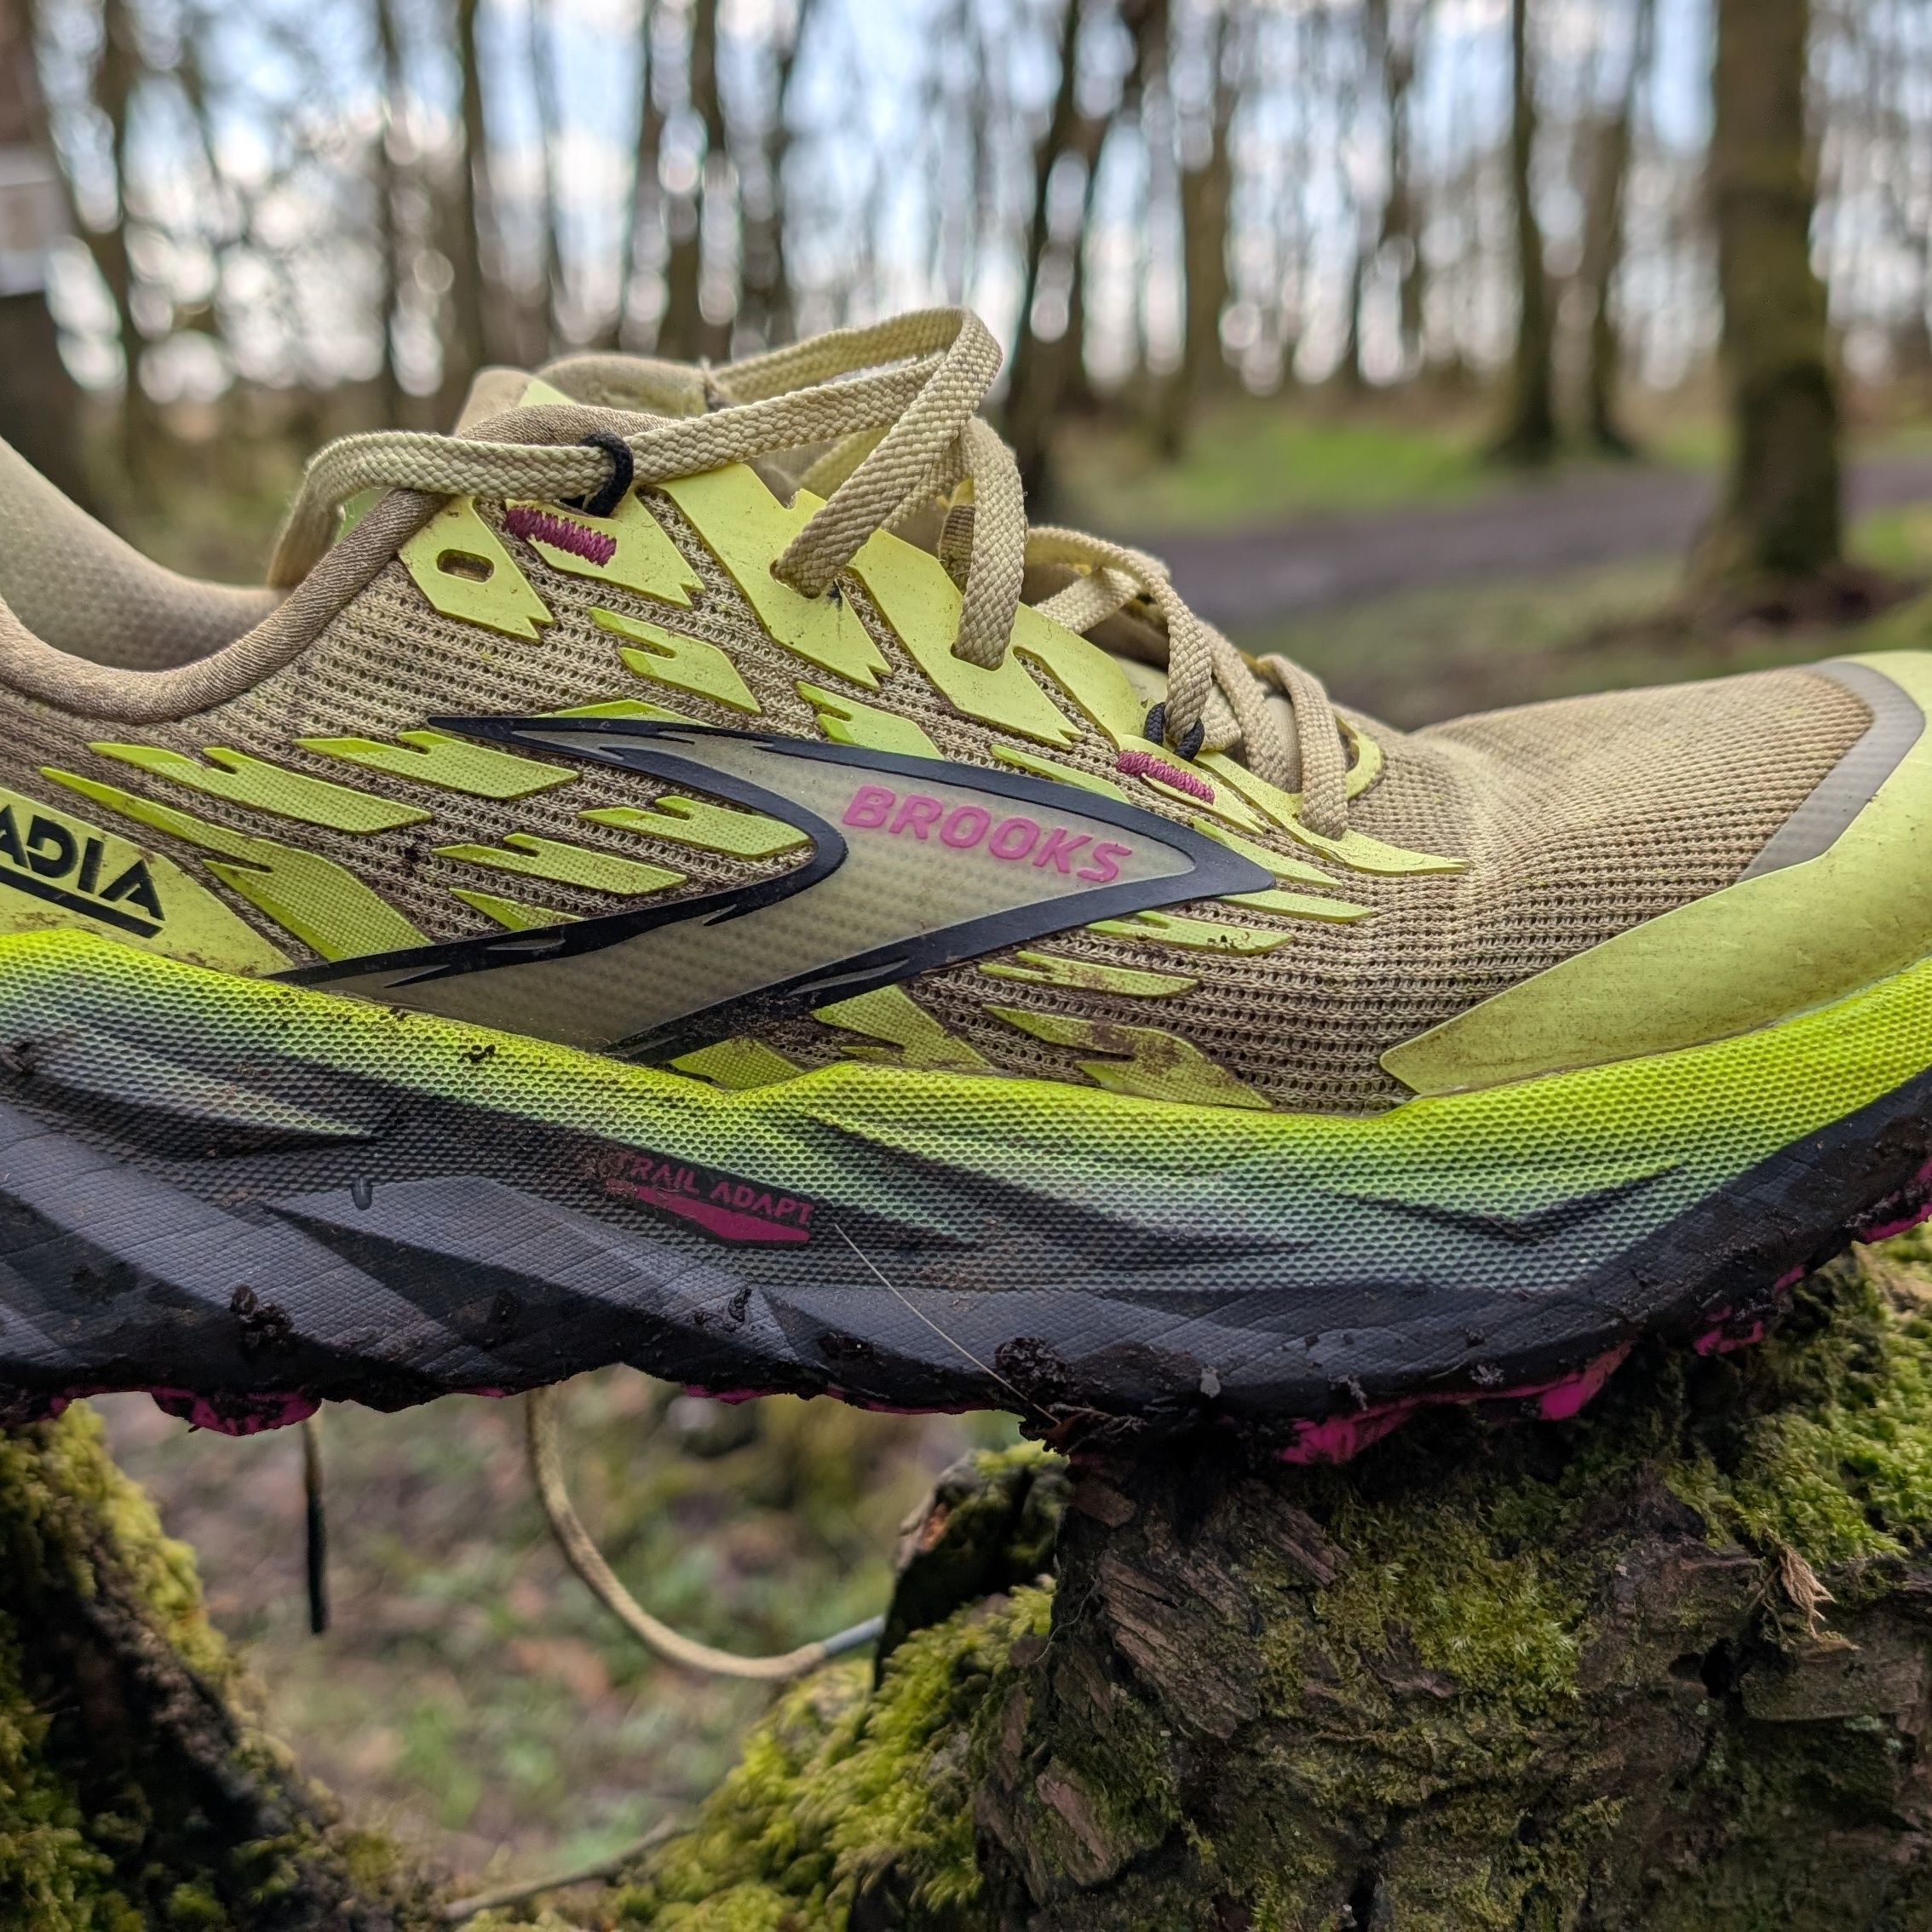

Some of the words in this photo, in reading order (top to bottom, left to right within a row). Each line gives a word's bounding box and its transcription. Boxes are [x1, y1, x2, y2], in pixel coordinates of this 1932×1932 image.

[843, 785, 1133, 883] BROOKS
[615, 1151, 699, 1194] TRAIL
[709, 1181, 814, 1224] ADAPT
